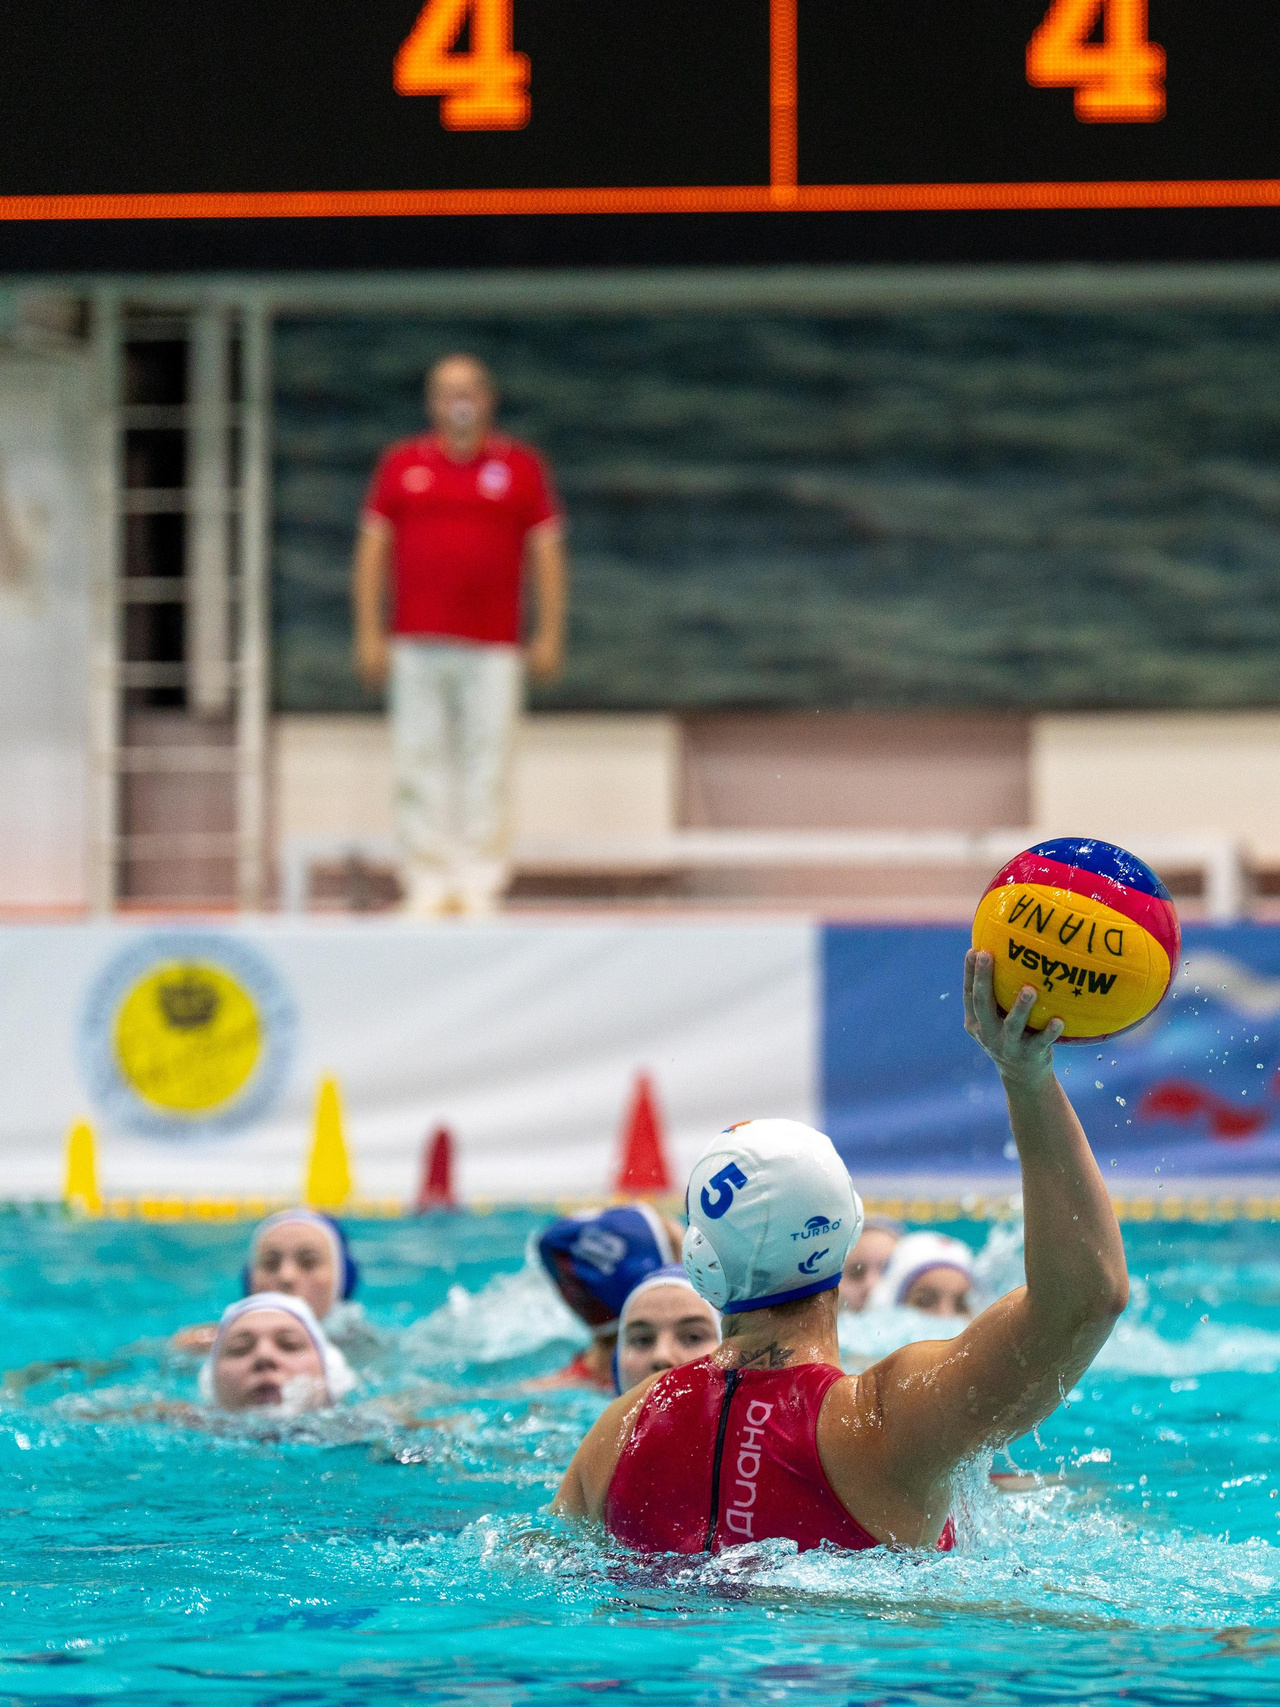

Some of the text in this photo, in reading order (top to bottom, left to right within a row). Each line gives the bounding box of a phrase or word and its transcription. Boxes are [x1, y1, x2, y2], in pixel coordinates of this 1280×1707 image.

[393, 0, 532, 131] 4
[1026, 0, 1167, 123] 4
[1008, 894, 1124, 957] DIANA
[700, 1161, 749, 1220] 5
[790, 1219, 842, 1242] TURBO
[725, 1399, 774, 1539] Диана
